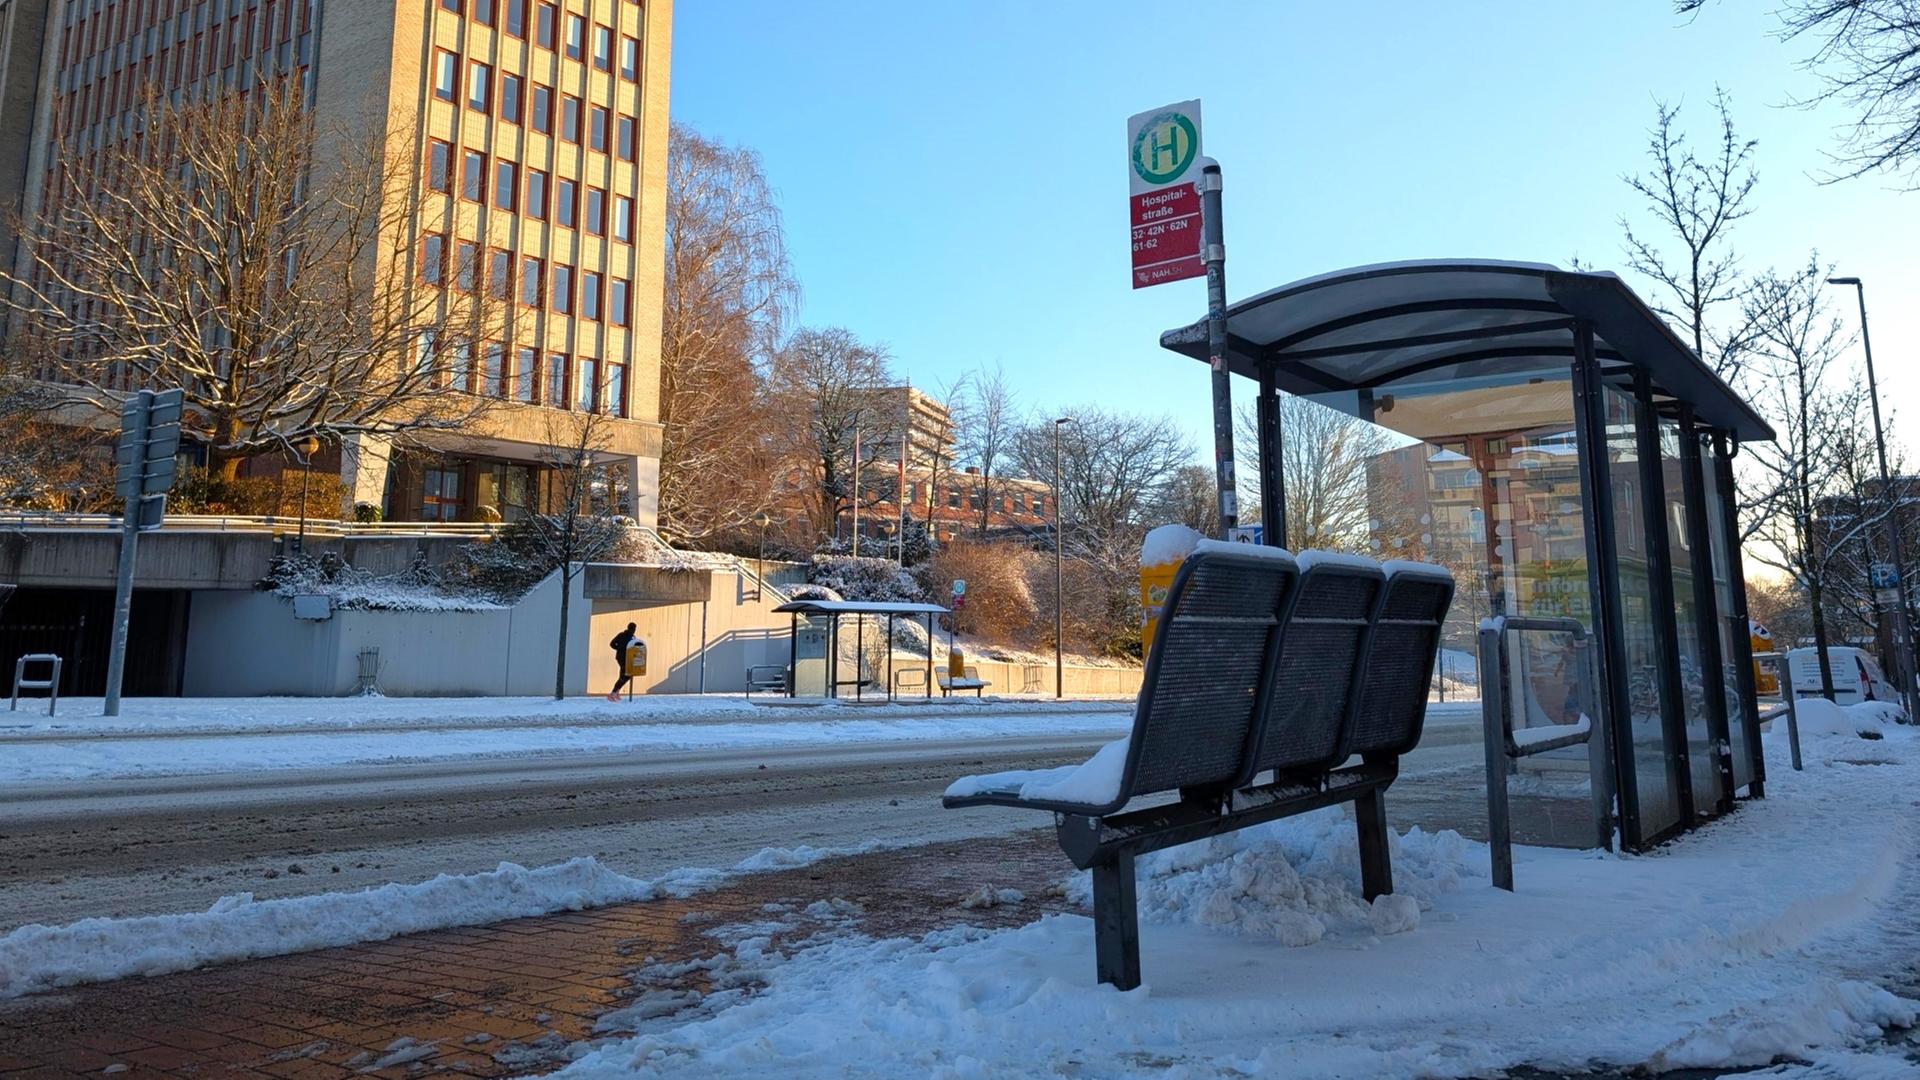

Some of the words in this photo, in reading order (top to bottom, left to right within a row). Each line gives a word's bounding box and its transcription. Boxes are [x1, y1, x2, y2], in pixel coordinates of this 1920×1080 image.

[1152, 126, 1178, 170] H
[1142, 188, 1187, 208] Hospital-
[1142, 206, 1174, 221] straße
[1147, 222, 1165, 237] 42N
[1169, 219, 1188, 232] 62N
